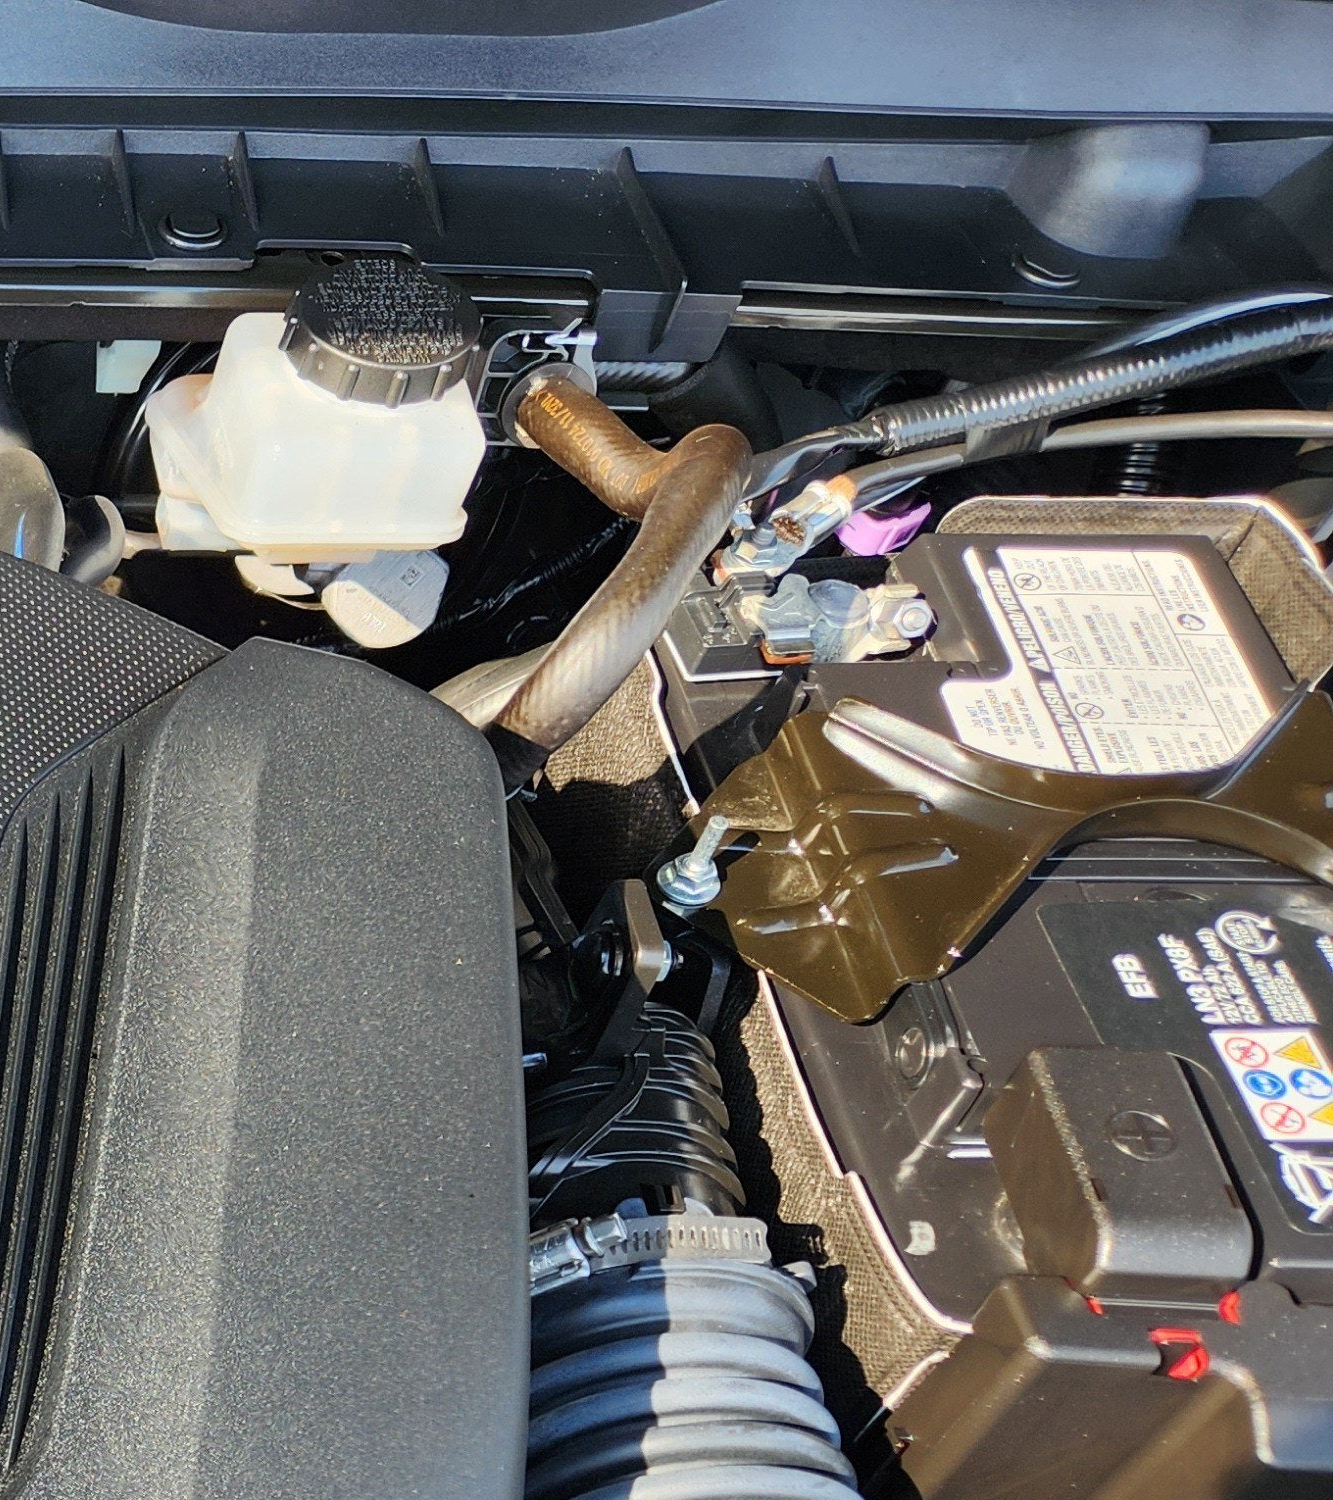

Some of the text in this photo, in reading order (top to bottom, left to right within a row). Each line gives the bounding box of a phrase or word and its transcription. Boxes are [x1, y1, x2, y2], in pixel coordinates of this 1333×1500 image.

[1037, 683, 1097, 771] DANGER/POISON
[1112, 953, 1159, 998] EFB
[1157, 933, 1229, 1024] LN3 PX8F
[1231, 996, 1263, 1023] CCA
